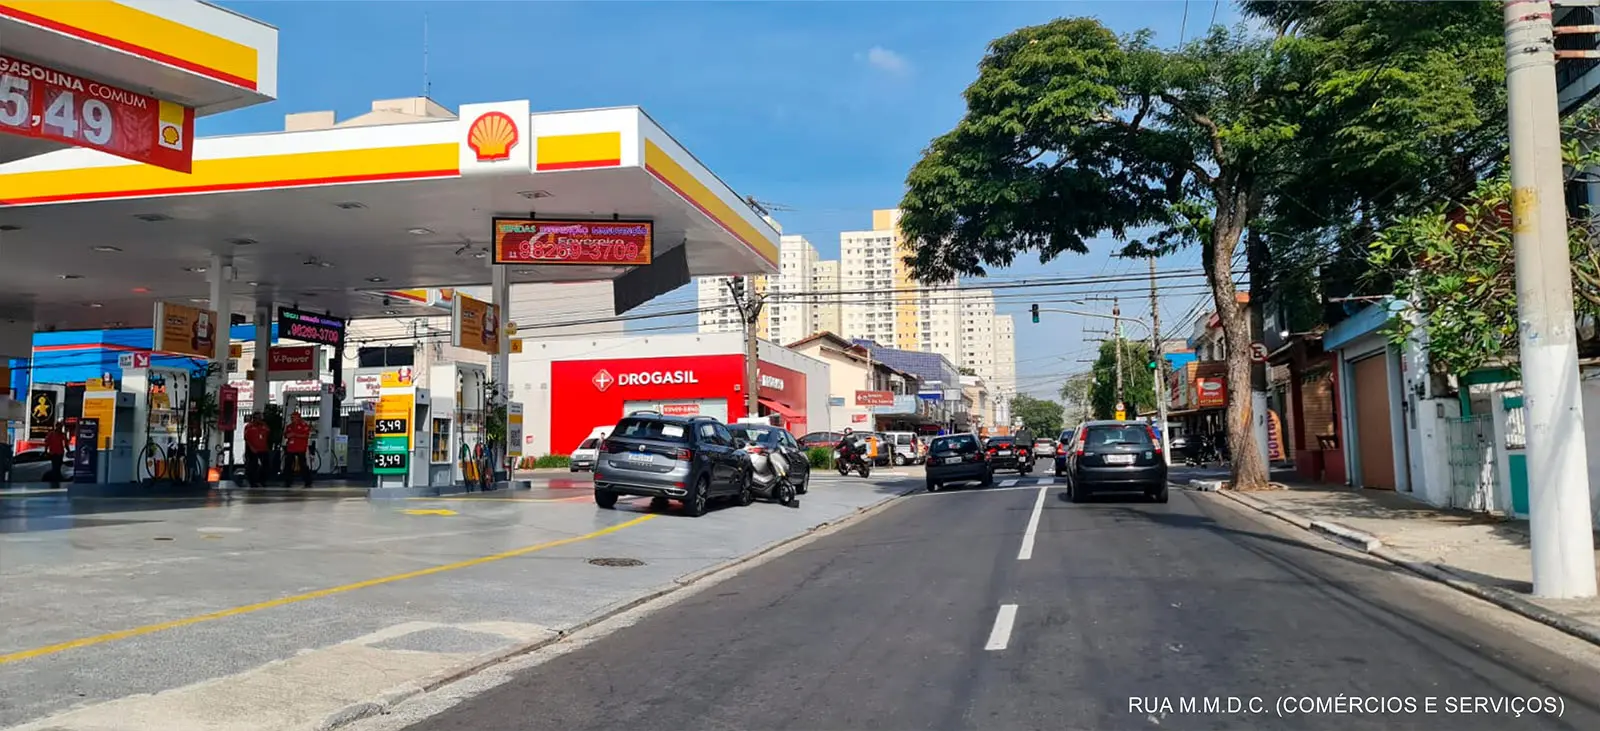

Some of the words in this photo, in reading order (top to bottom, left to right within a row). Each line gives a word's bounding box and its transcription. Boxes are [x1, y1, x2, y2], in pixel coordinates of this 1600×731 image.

[0, 57, 84, 92] GASOLINA
[88, 83, 147, 109] COMUM
[0, 73, 112, 145] 5,49
[519, 240, 638, 259] 98269-3709
[273, 355, 309, 363] V-Power
[618, 370, 699, 386] DROGASIL
[379, 420, 401, 433] 5,49
[379, 455, 400, 468] 3,49
